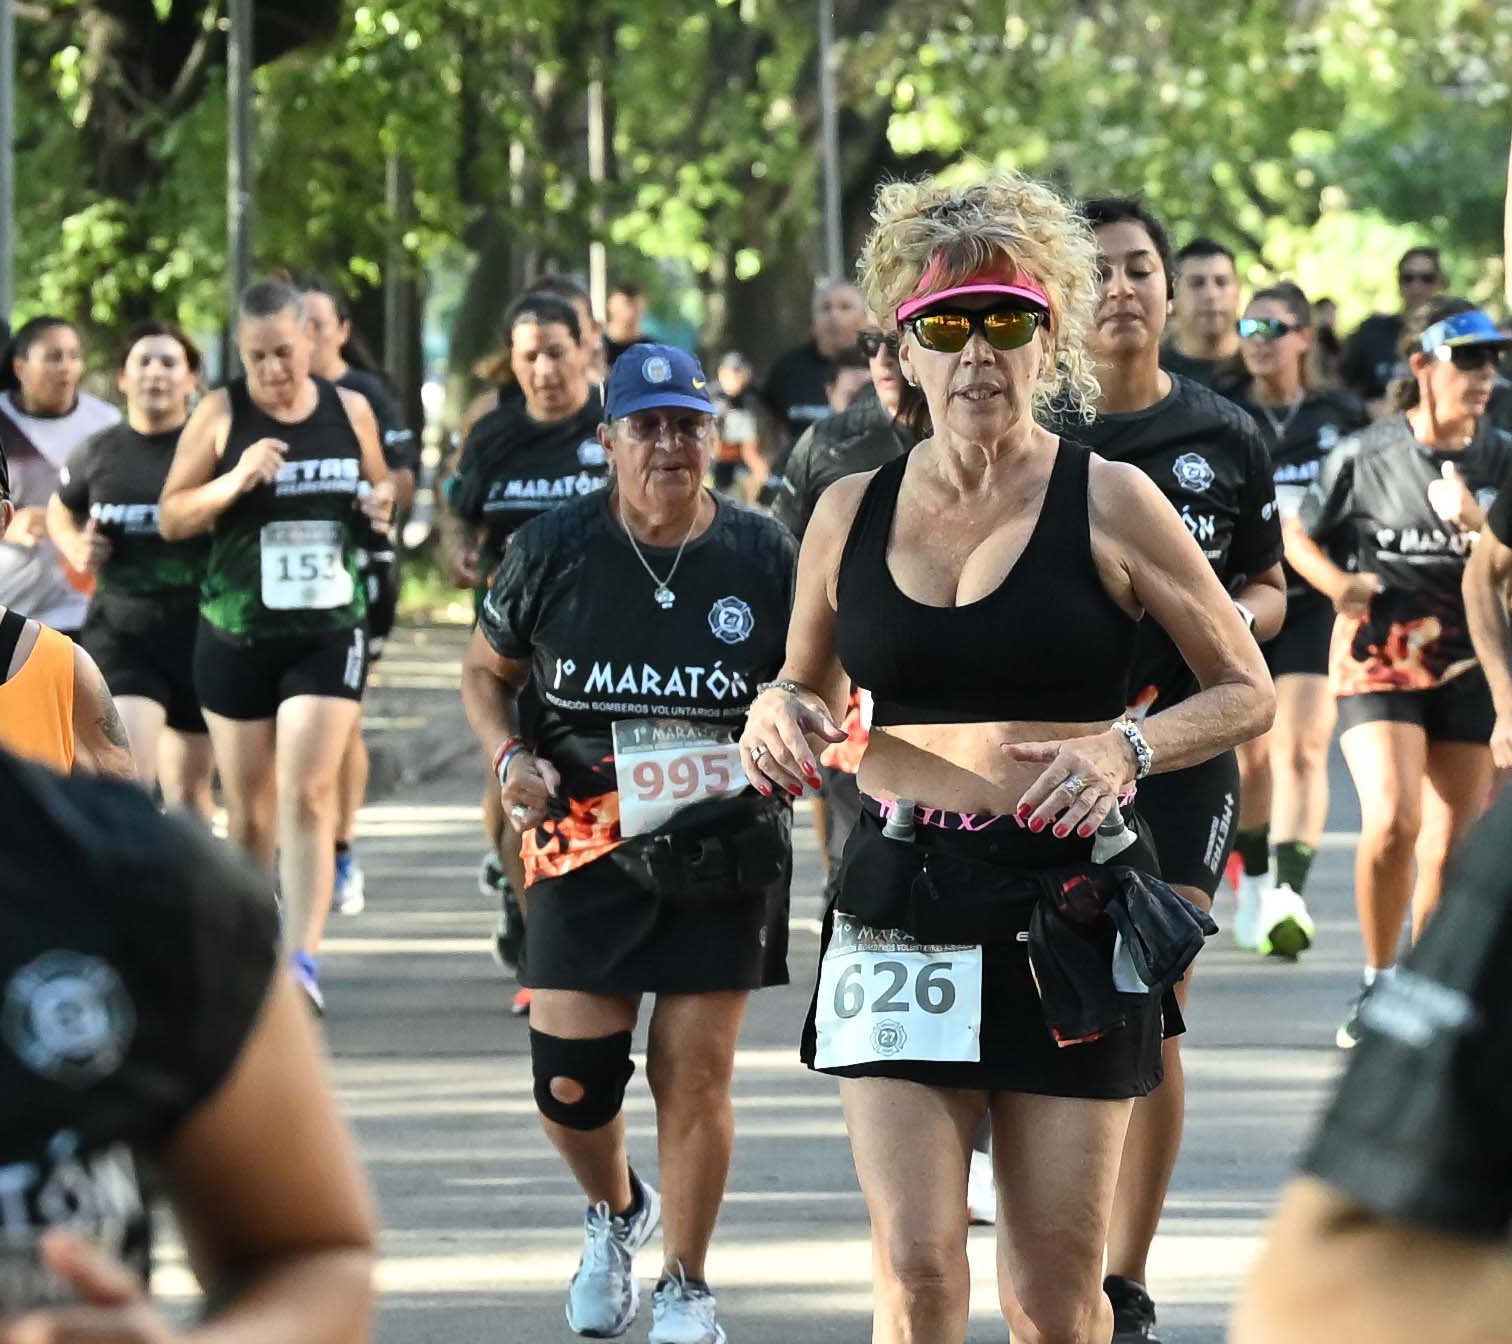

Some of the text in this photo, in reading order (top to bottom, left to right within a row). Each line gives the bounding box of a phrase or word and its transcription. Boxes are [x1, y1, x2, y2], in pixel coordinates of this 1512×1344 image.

[584, 659, 749, 701] MARATÓN
[591, 701, 649, 715] BOMBEROS
[651, 704, 721, 718] VOLUNTARIOS
[631, 752, 732, 802] 995
[833, 961, 957, 1020] 626
